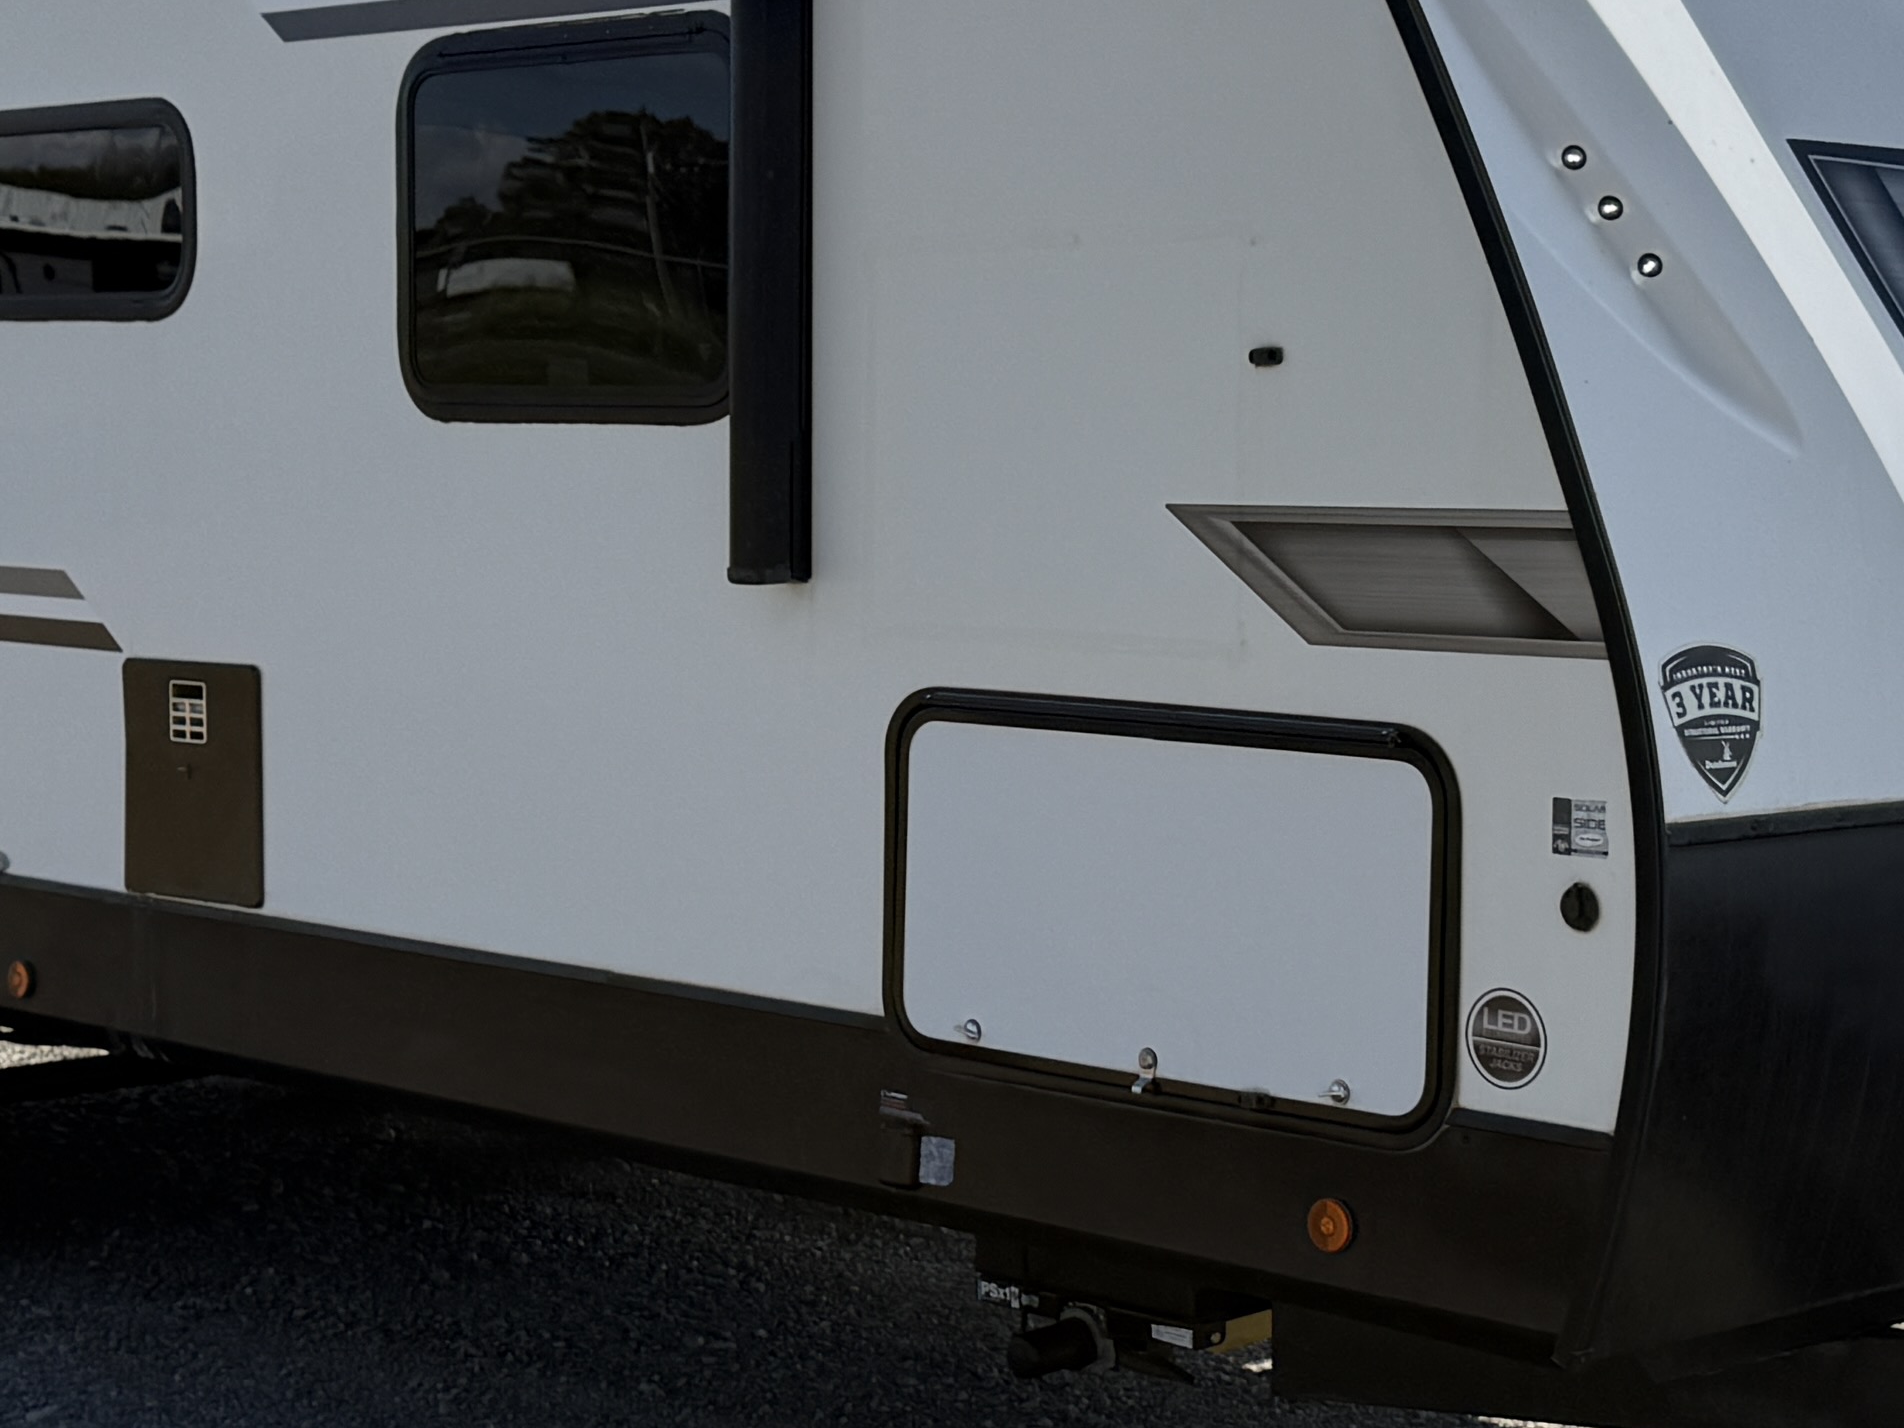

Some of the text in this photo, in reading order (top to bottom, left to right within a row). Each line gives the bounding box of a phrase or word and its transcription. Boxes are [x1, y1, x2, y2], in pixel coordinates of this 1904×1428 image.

[1671, 682, 1755, 719] 3 YEAR
[1482, 1006, 1532, 1035] LED
